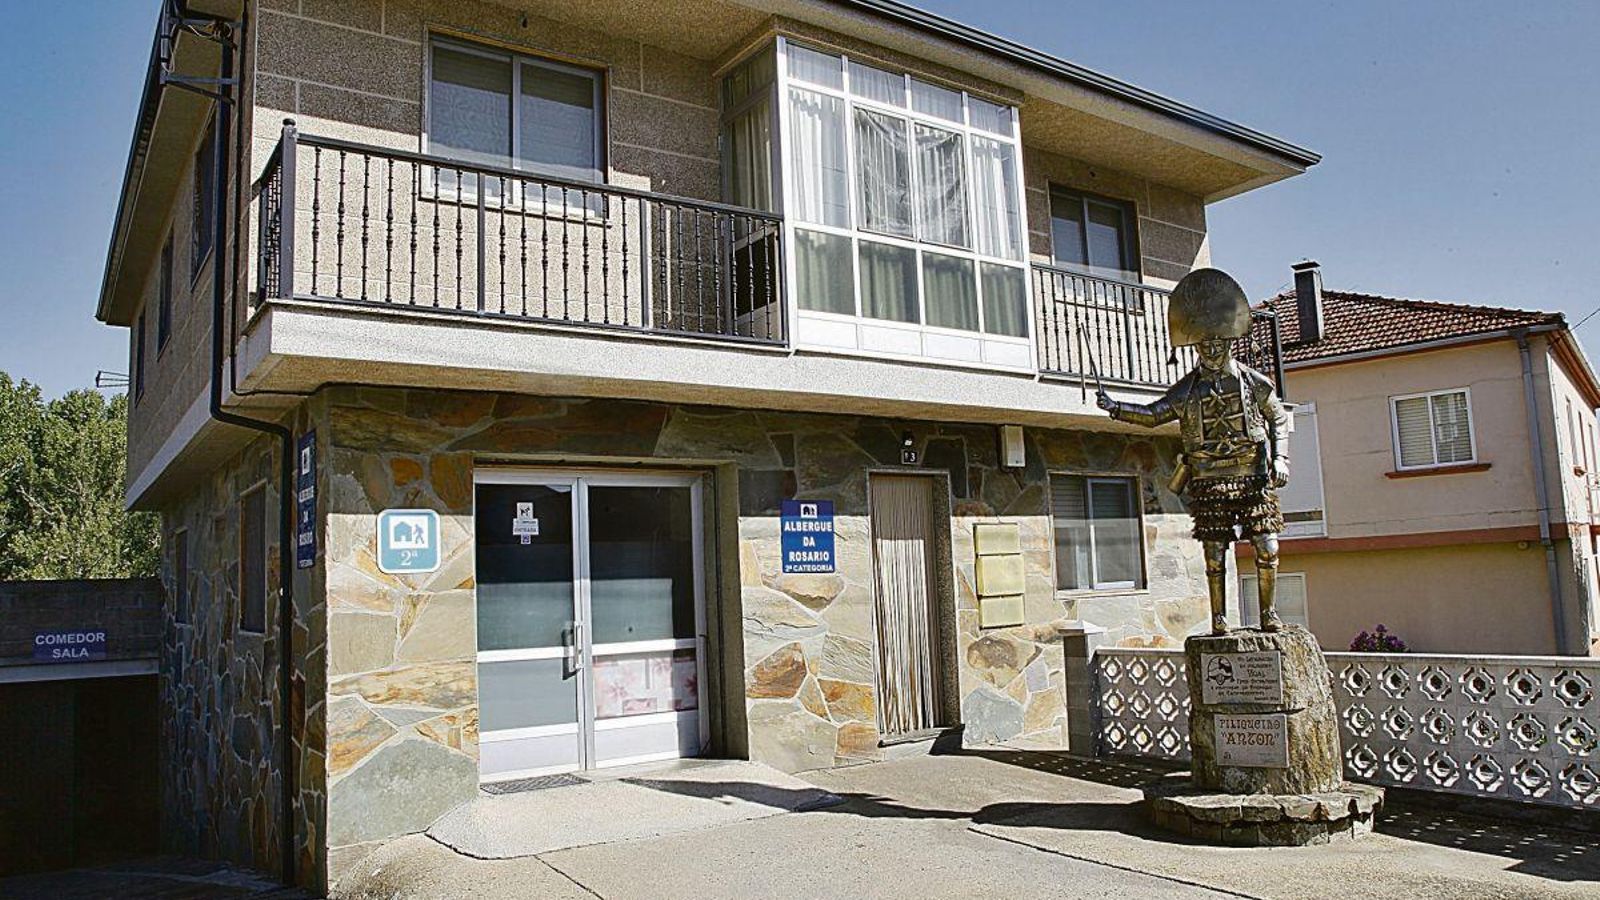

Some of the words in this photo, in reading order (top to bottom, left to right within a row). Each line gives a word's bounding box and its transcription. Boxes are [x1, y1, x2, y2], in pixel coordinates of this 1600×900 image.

[784, 521, 832, 532] ALBERGUE
[803, 536, 815, 547] DA
[788, 551, 830, 562] ROSARIO
[793, 564, 833, 572] CATEGORIA
[35, 632, 105, 645] COMEDOR
[52, 647, 89, 659] SALA
